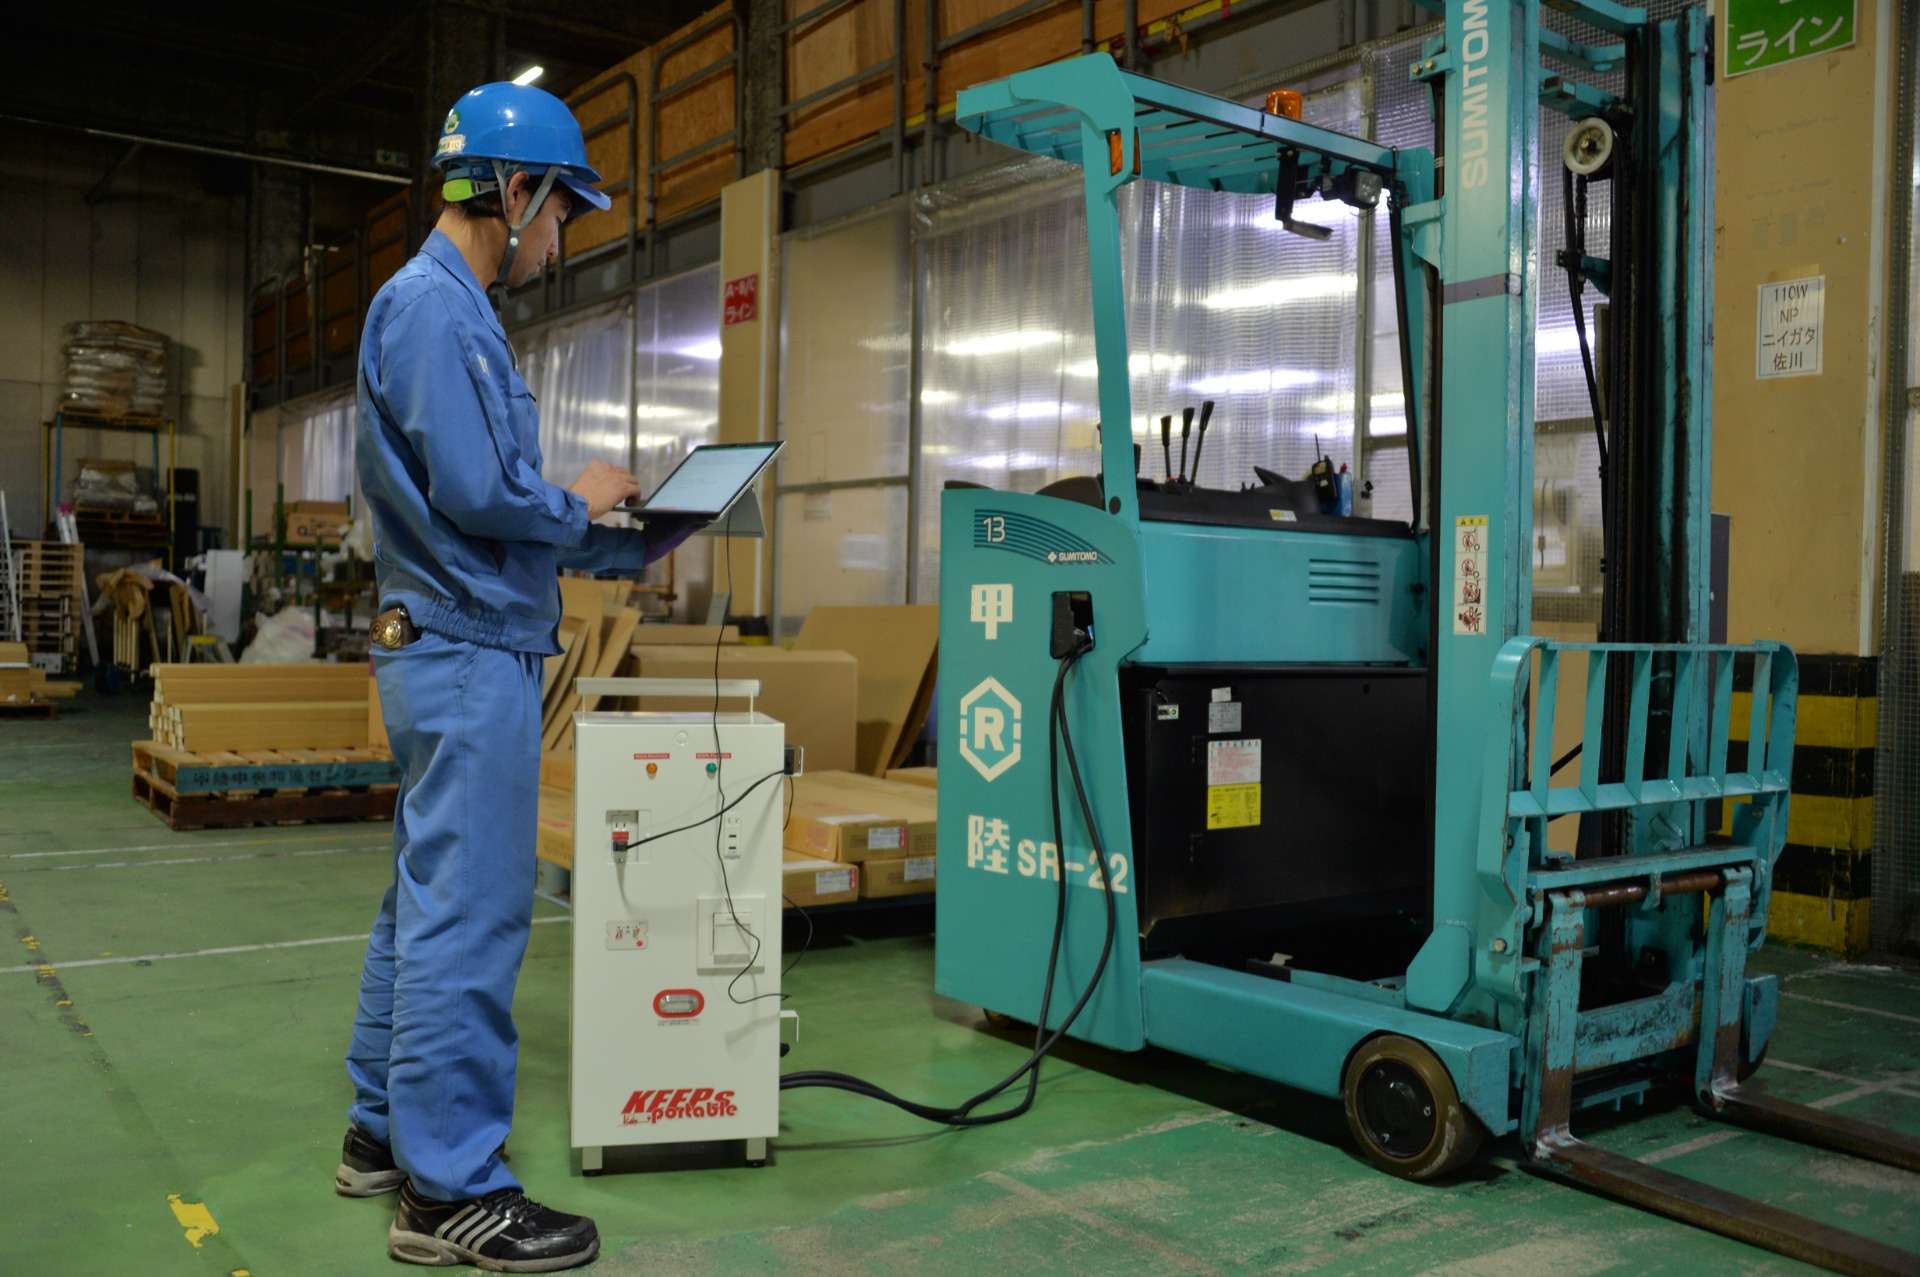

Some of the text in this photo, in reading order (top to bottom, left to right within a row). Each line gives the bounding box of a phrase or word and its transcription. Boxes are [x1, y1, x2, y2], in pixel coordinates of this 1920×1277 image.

[1736, 16, 1844, 66] ライン
[1774, 283, 1808, 302] 110W
[725, 303, 753, 323] ライン
[1779, 307, 1800, 323] NP
[1762, 328, 1816, 348] ニイガタ
[1773, 351, 1803, 371] 佐川
[983, 516, 1006, 543] 13
[1058, 550, 1098, 562] SUMITOMO
[973, 706, 1006, 752] R
[1017, 838, 1129, 894] SR-22
[651, 1101, 738, 1124] portable
